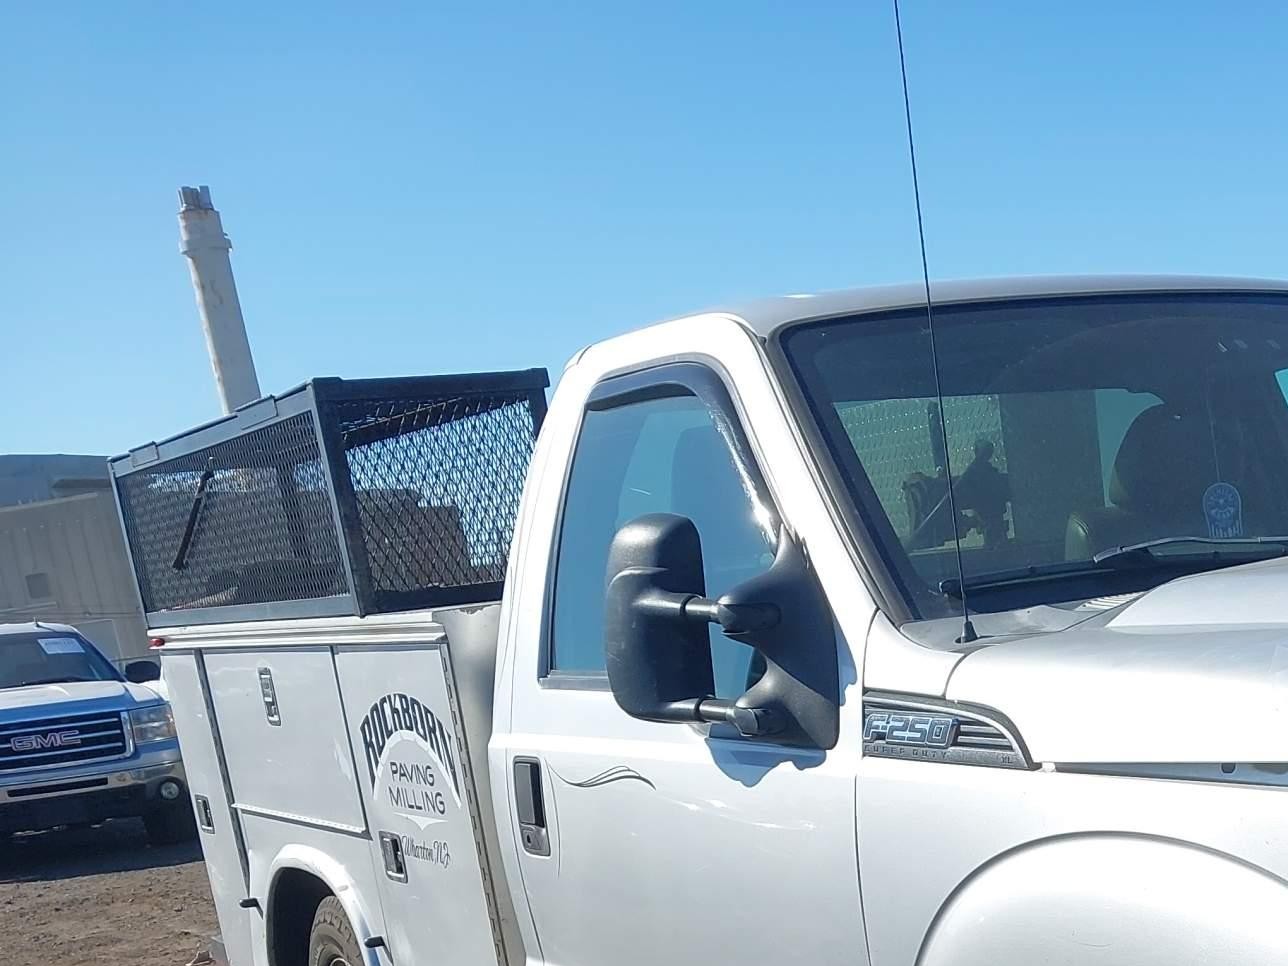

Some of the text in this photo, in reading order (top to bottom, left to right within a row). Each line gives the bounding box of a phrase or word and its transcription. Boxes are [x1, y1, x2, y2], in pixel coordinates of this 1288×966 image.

[11, 730, 82, 751] GMC
[863, 714, 953, 746] F-250
[360, 693, 461, 800] ROCKBORN
[912, 748, 947, 759] DUTY
[390, 762, 435, 787] PAVING
[388, 787, 446, 815] MILLING
